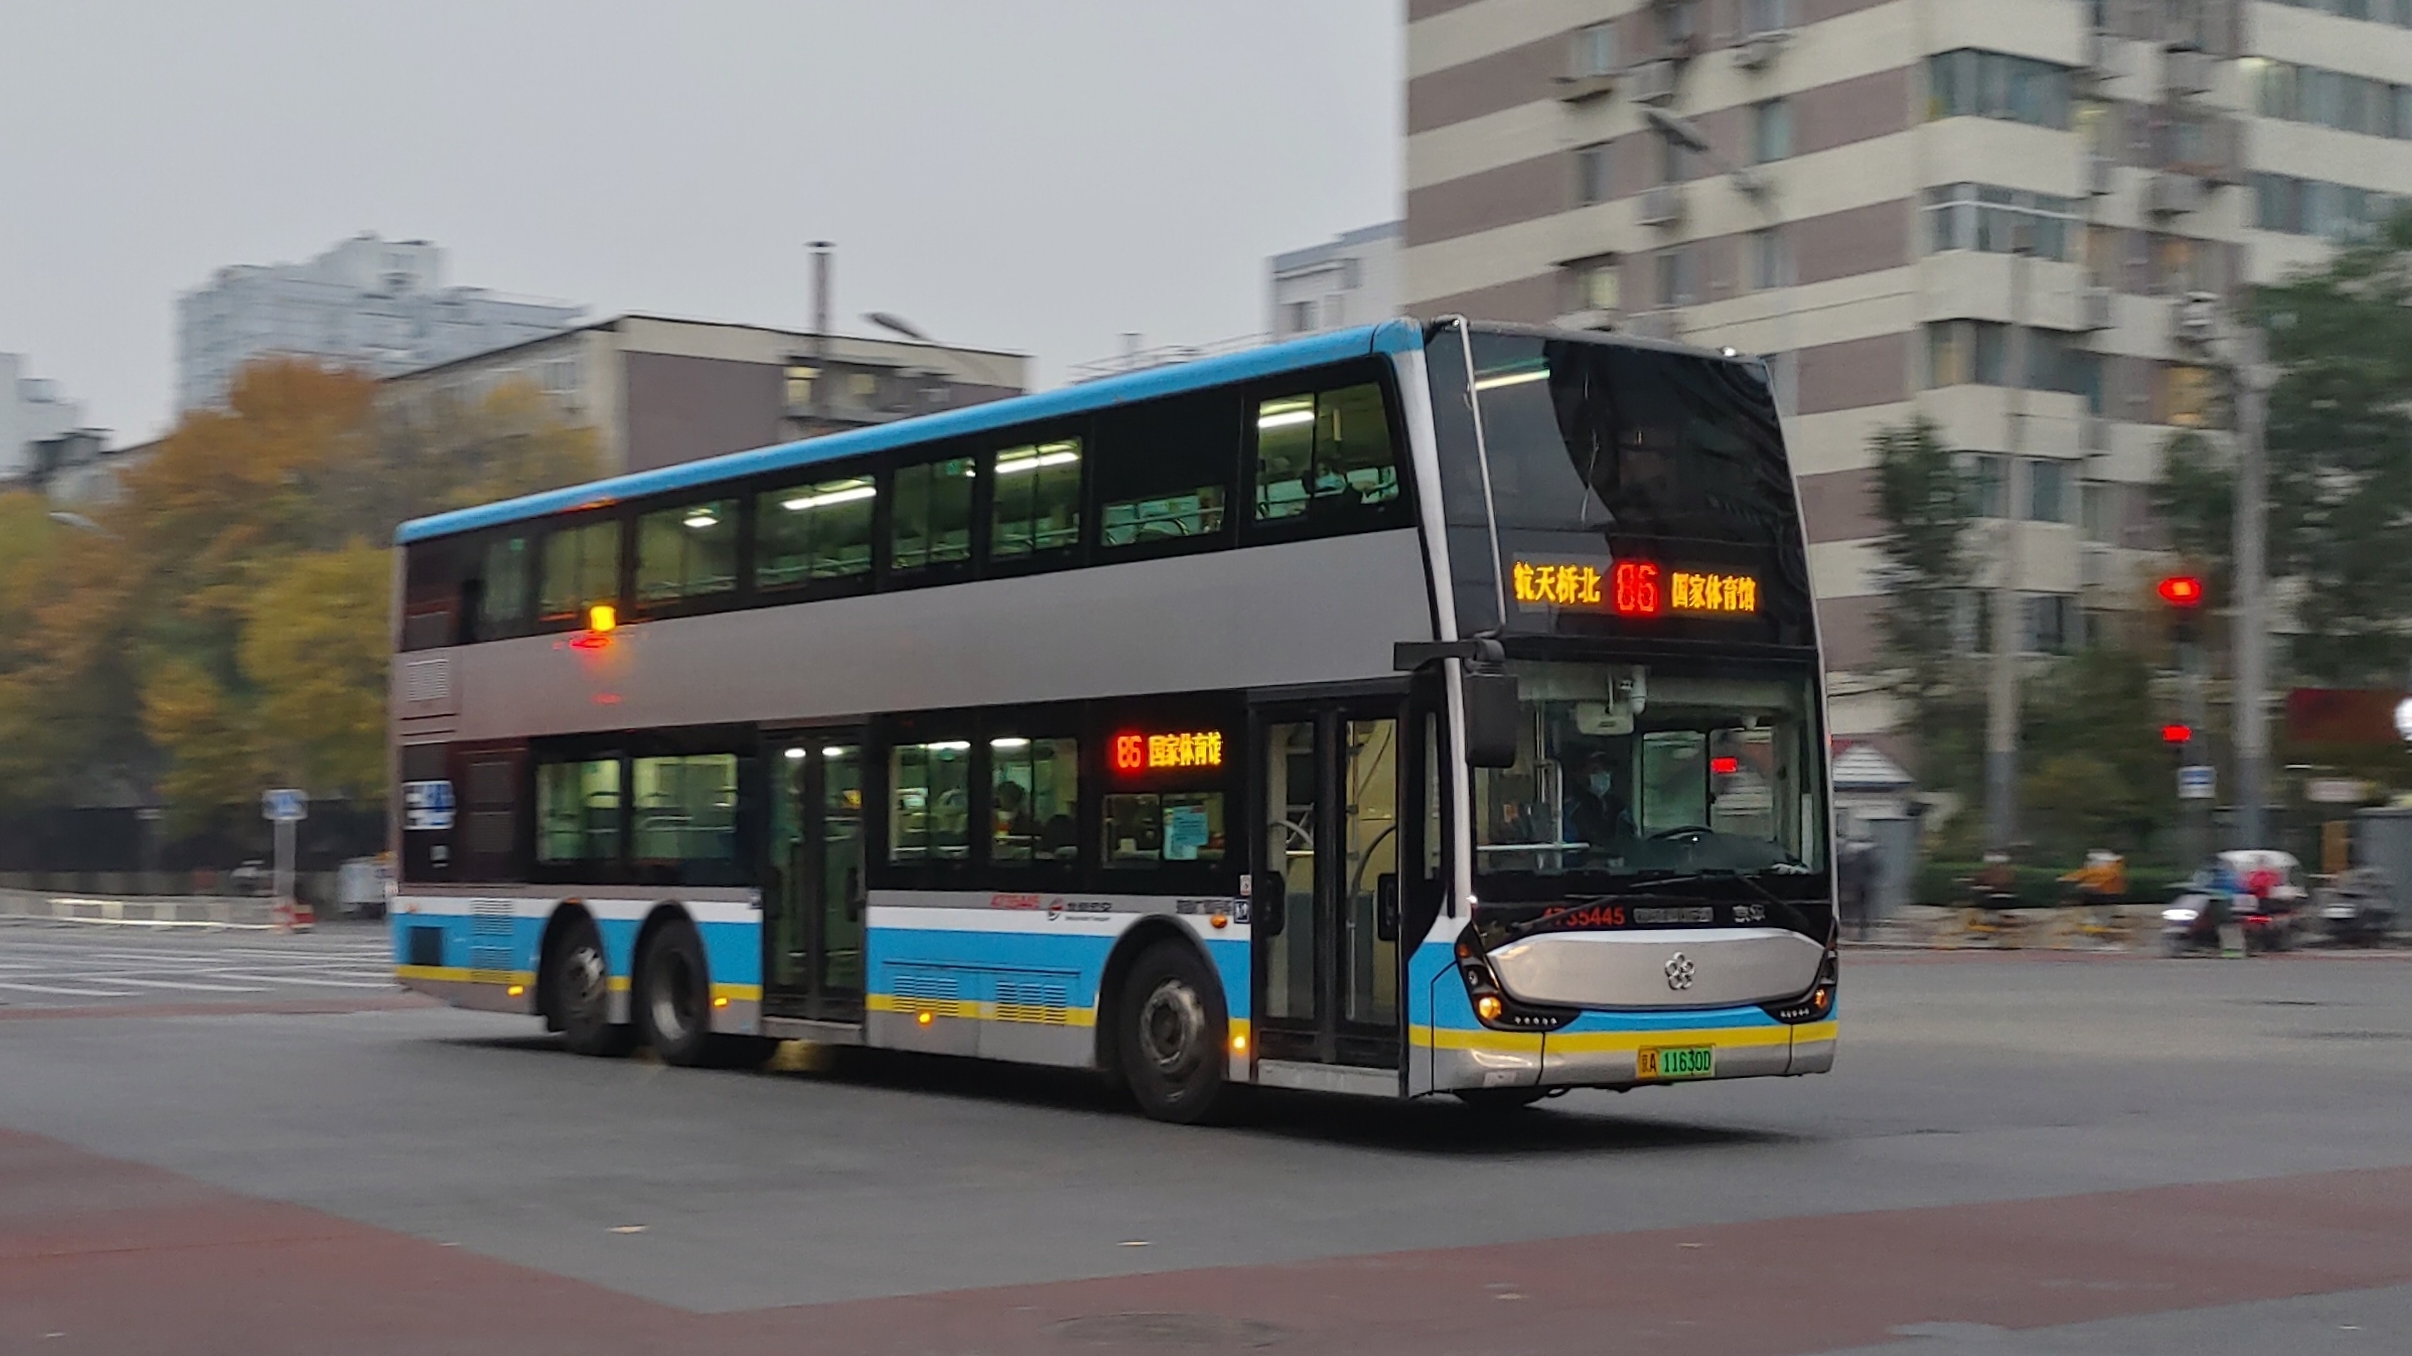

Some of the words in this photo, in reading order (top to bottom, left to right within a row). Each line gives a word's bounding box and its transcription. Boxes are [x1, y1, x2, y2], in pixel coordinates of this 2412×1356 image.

[1513, 561, 1601, 604] 航天桥北
[1617, 563, 1657, 612] 86
[1672, 572, 1756, 611] 国家体育馆
[1117, 735, 1142, 767] 86
